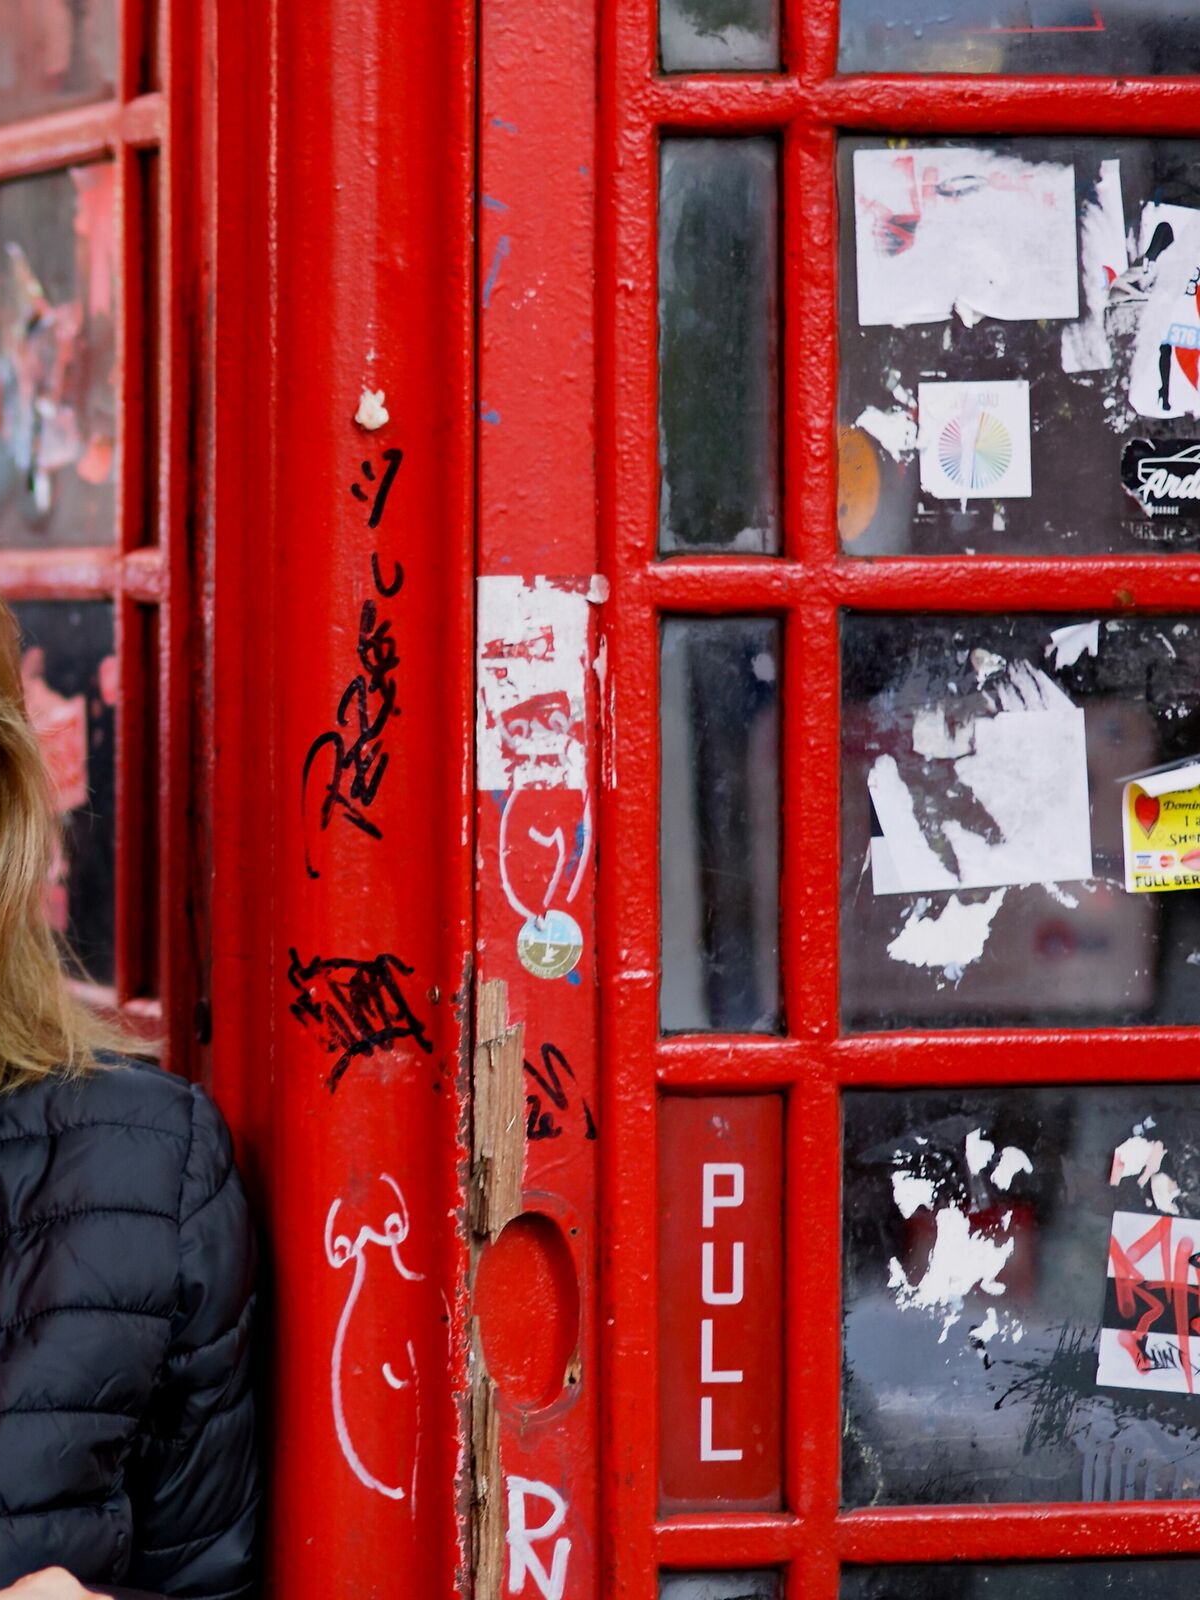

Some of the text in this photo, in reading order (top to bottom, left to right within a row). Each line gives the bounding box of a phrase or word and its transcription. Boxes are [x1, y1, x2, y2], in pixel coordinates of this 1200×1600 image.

[1135, 873, 1200, 888] FULL SER
[700, 1162, 745, 1462] PULL
